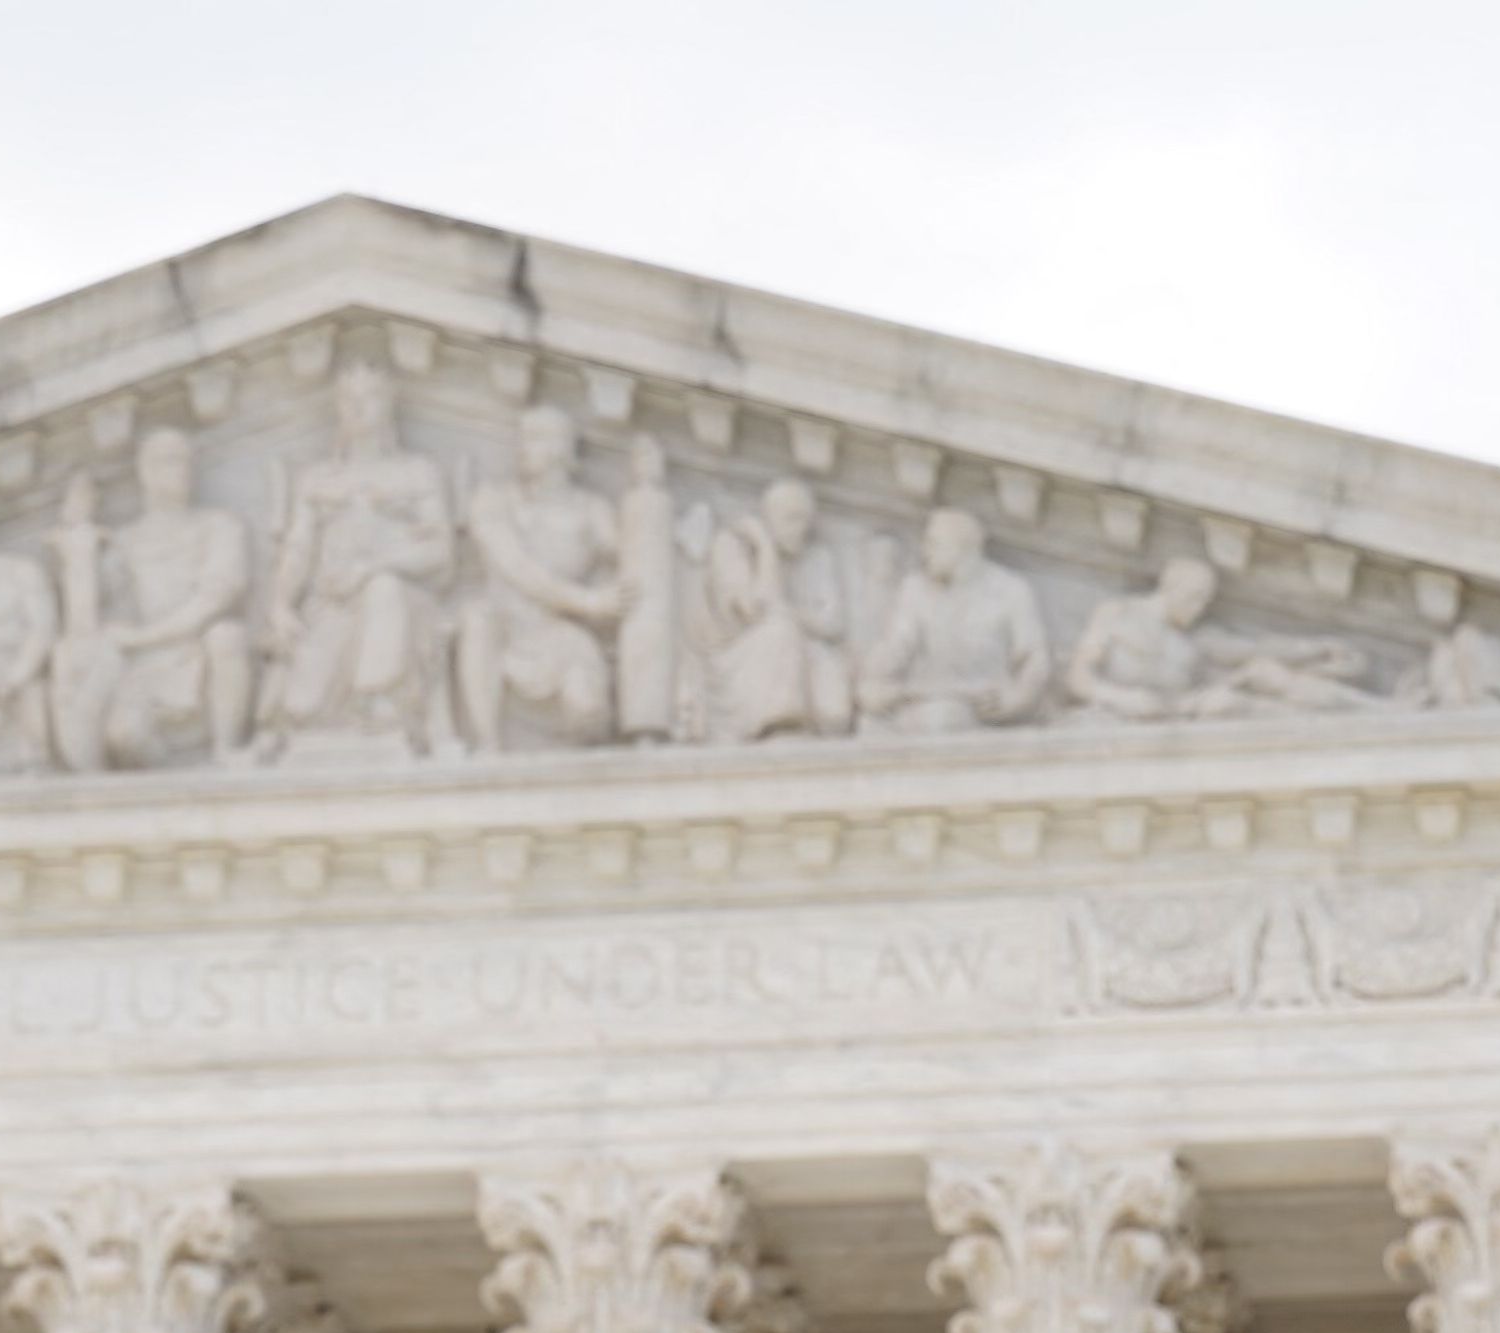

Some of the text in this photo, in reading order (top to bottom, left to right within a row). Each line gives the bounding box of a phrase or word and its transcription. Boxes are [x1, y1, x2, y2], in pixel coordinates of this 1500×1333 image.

[62, 950, 424, 1042] JUSTICE
[465, 934, 778, 1020] UNDER
[810, 926, 992, 1003] LAW
